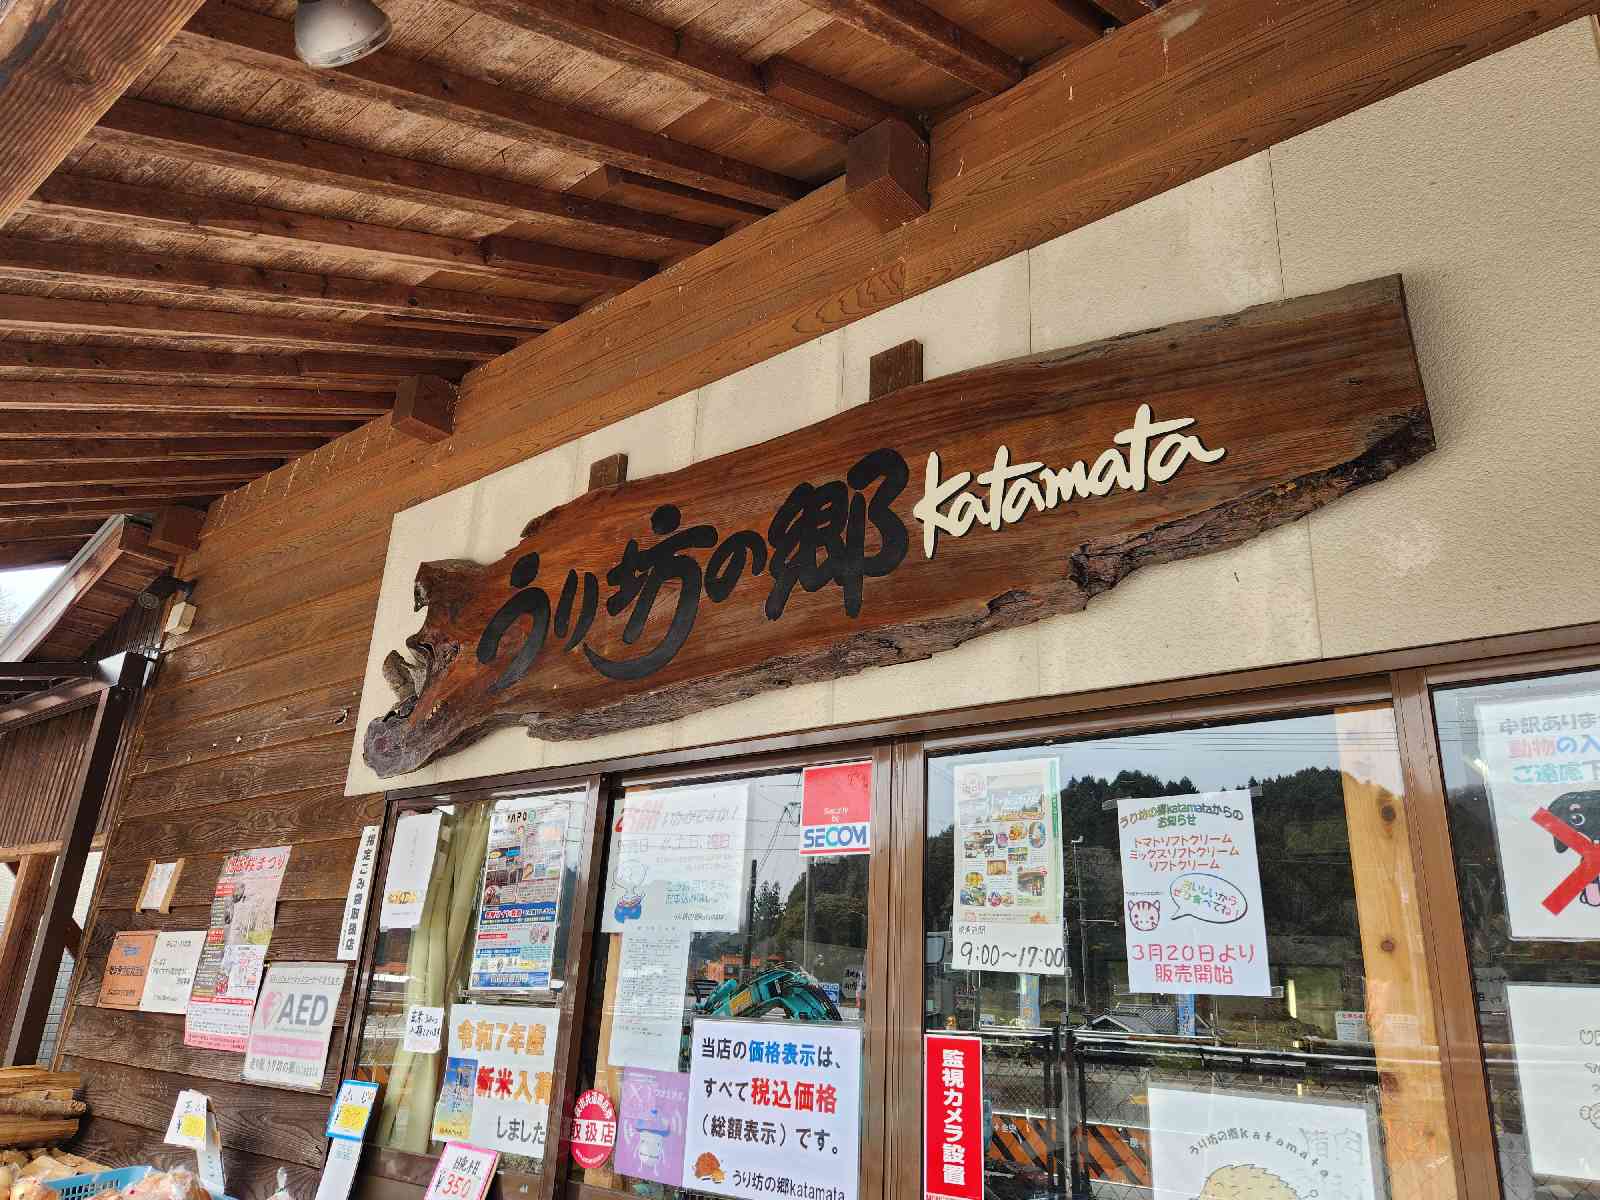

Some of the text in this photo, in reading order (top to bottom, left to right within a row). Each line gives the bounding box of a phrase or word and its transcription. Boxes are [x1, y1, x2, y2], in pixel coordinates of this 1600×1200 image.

[477, 404, 1225, 694] うり坊の郷 katamata
[1500, 712, 1600, 736] 申訳ありま
[804, 826, 867, 849] SECOM
[1132, 943, 1256, 964] 3月20日より
[1155, 963, 1234, 985] 販売開始
[276, 993, 329, 1026] AED
[457, 1018, 548, 1056] 令和7年産
[701, 1037, 841, 1069] 当店の価格表示は、
[703, 1077, 838, 1114] すべて税込価格
[497, 1114, 546, 1145] しました
[571, 1120, 615, 1145] 取扱店
[942, 1049, 966, 1186] 監視カメラ設置
[732, 1169, 846, 1200] うり坊の郷katamata
